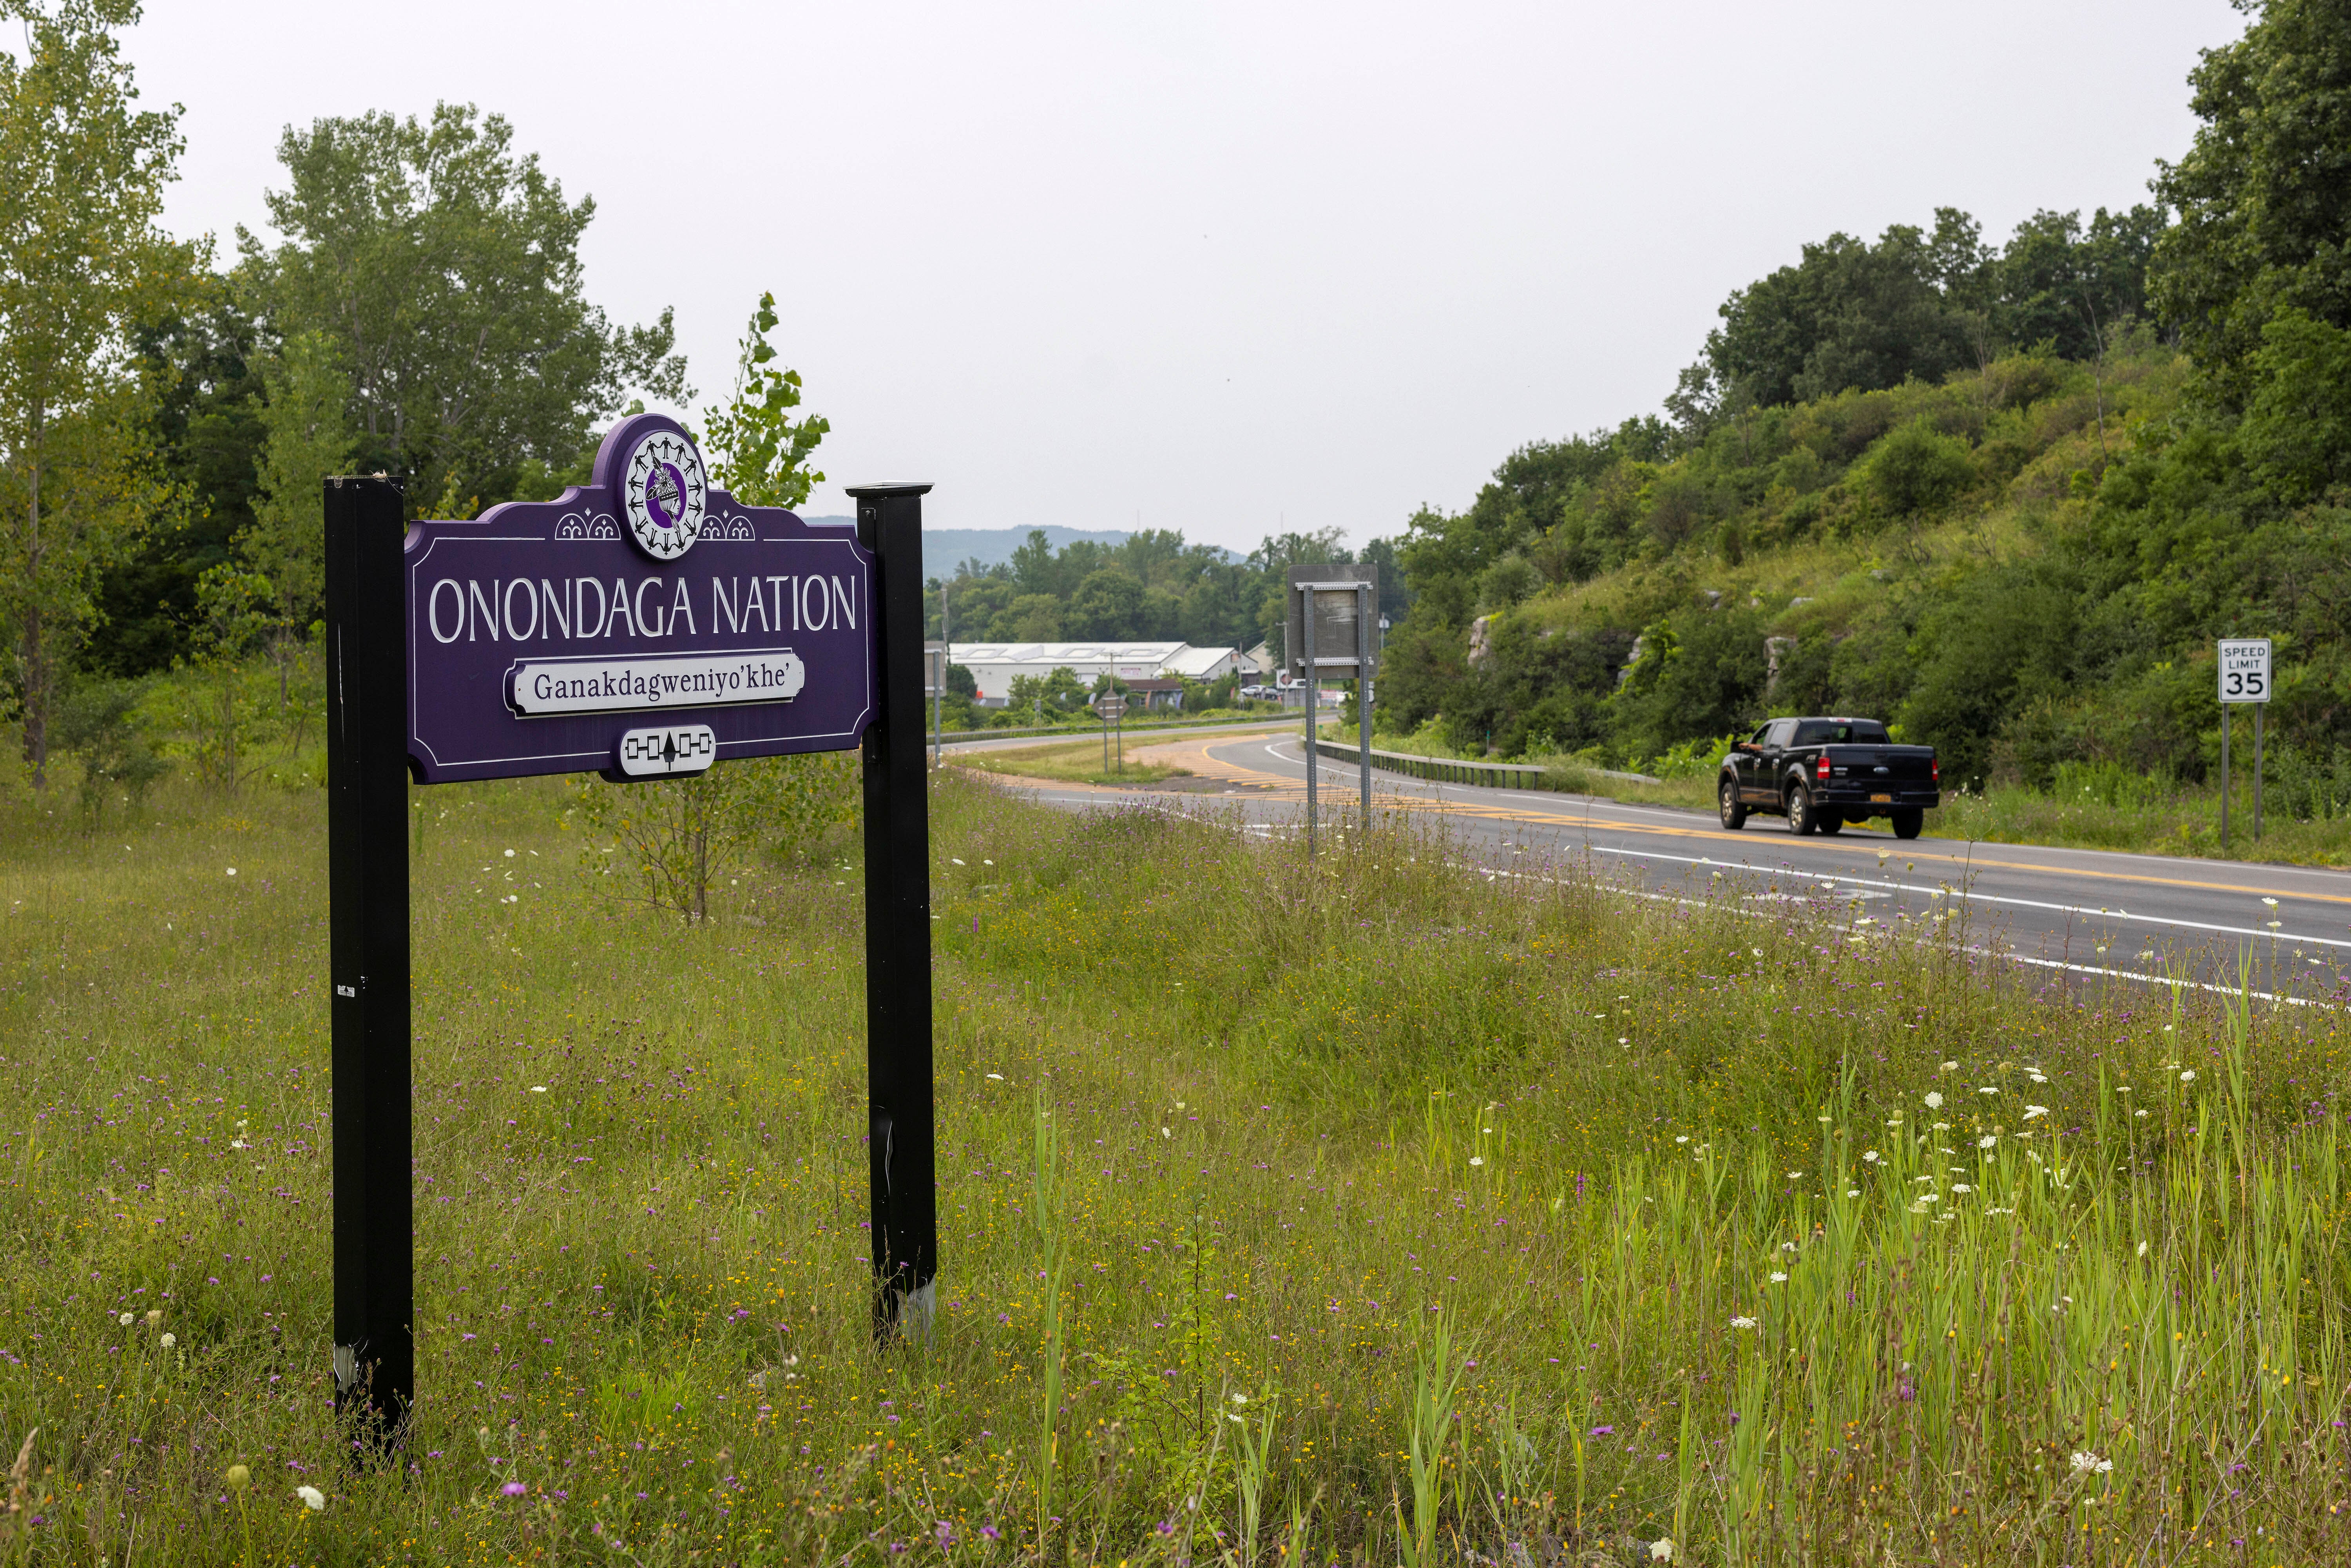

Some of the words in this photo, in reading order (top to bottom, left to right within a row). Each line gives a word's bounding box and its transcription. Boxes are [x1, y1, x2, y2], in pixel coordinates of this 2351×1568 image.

[429, 577, 697, 643] ONONDAGA
[712, 574, 856, 634] NATION
[2224, 647, 2265, 657] SPEED
[2229, 659, 2260, 669] LIMIT
[534, 663, 790, 702] Ganakdagweniyo'khe'
[2226, 672, 2264, 695] 35
